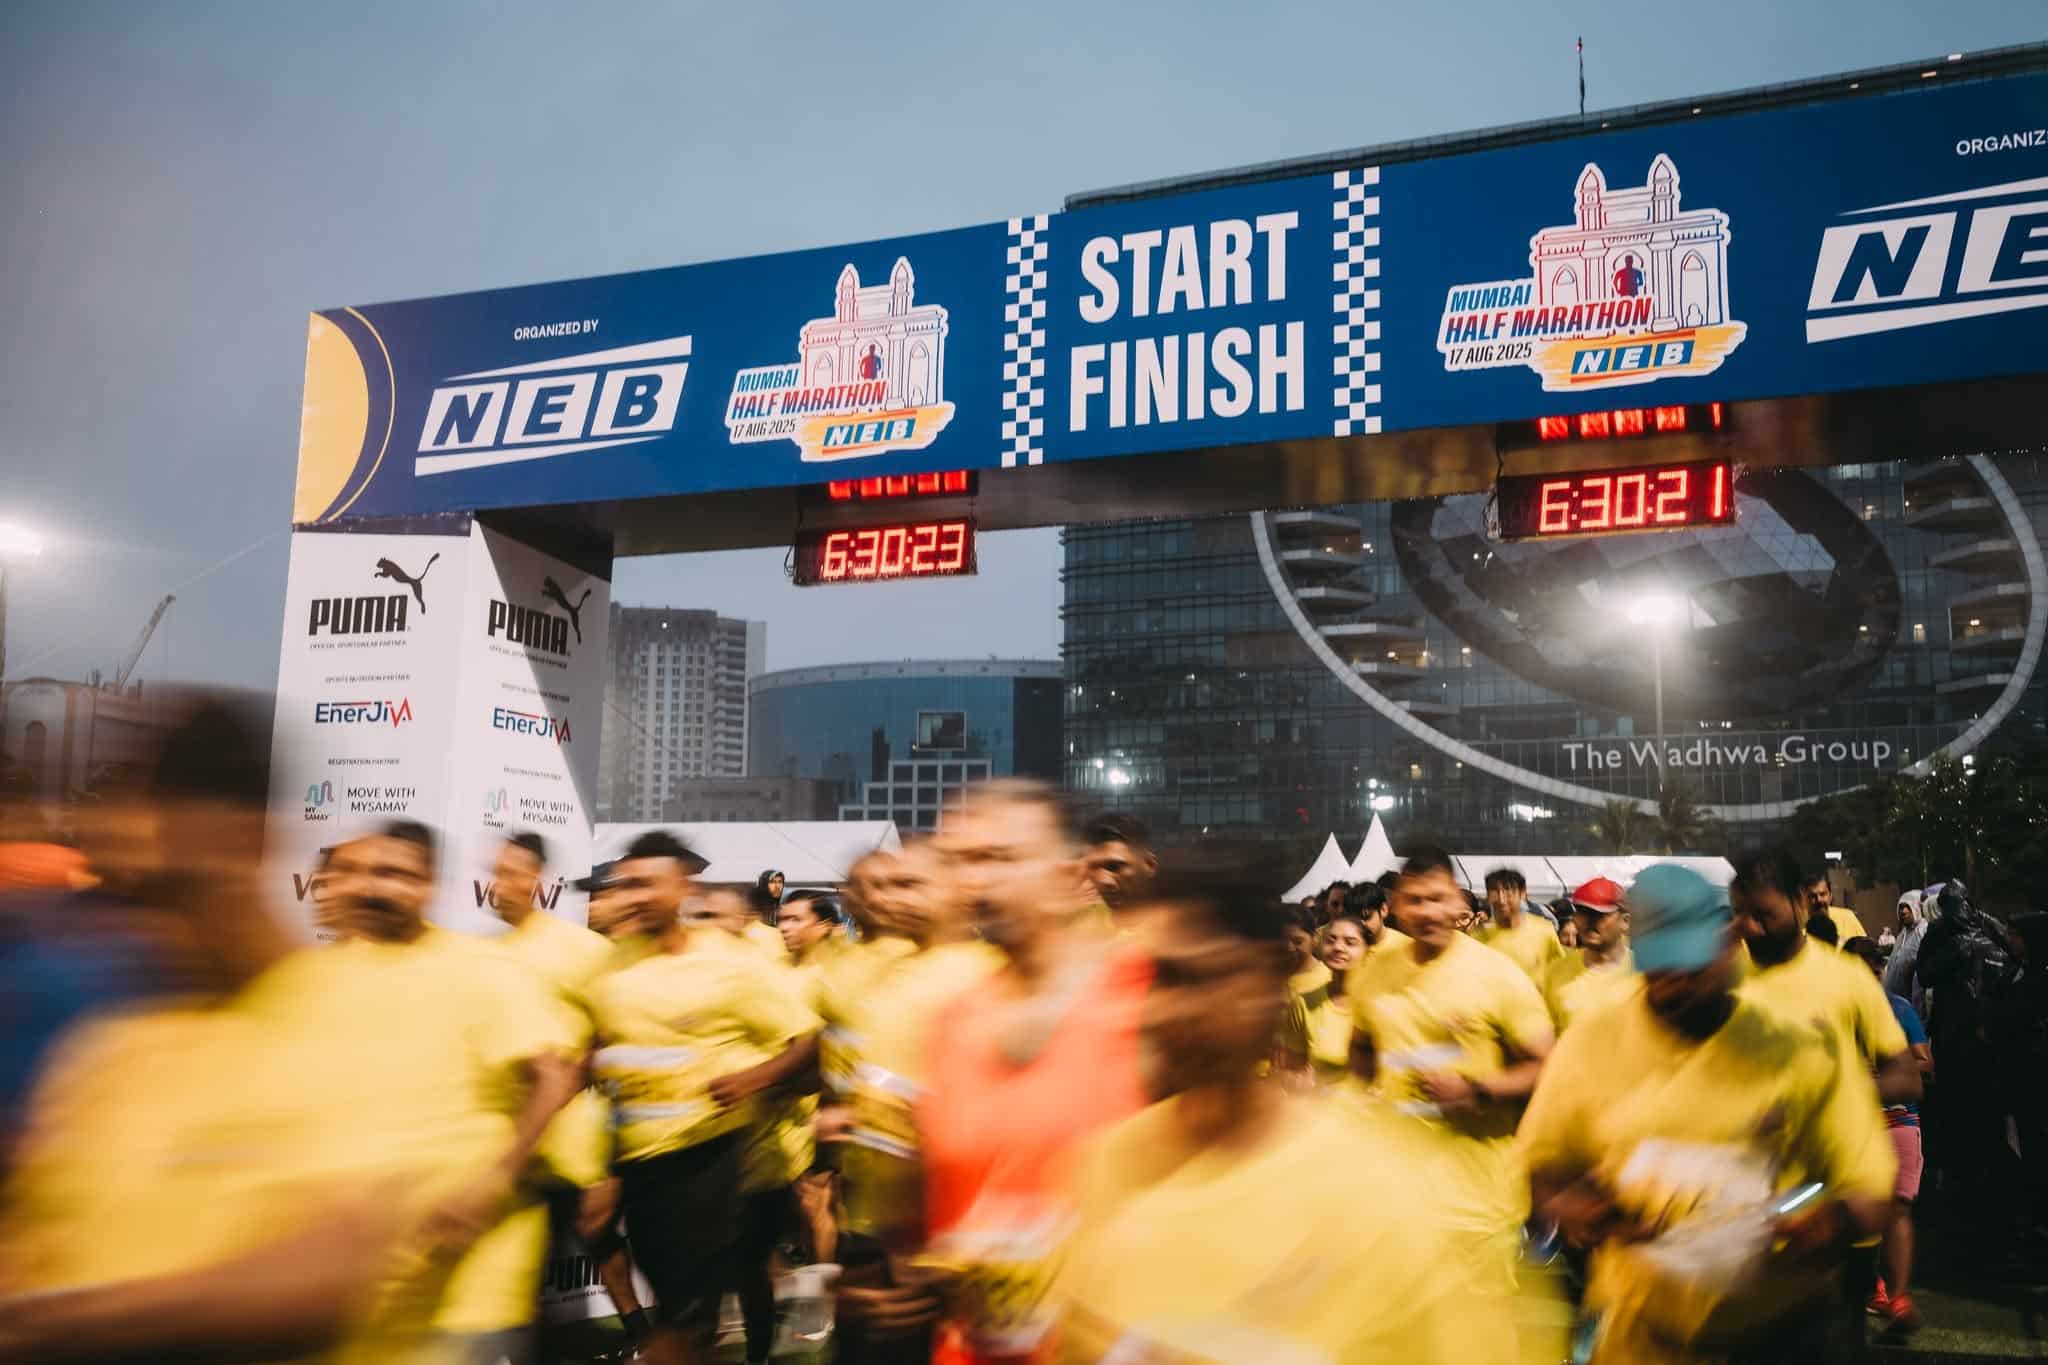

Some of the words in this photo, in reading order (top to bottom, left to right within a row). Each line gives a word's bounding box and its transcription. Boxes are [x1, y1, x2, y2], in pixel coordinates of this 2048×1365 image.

[1955, 129, 2048, 156] ORGANIZ
[1078, 210, 1299, 323] START
[1829, 210, 2048, 305] NE
[1450, 284, 1532, 313] MUMBAI
[513, 320, 581, 341] ORGANIZED
[582, 318, 600, 334] BY
[1445, 311, 1508, 345] HALF
[1511, 297, 1652, 337] MARATHON
[1449, 348, 1464, 366] 17
[1465, 345, 1494, 364] AUG
[1495, 342, 1533, 362] 2025
[1574, 341, 1691, 374] NEB
[737, 368, 799, 392] MUMBAI
[1069, 320, 1305, 433] FINISH
[429, 371, 668, 449] NEB
[731, 393, 780, 419] HALF
[780, 380, 888, 415] MARATHON
[734, 423, 745, 439] 17
[745, 421, 767, 437] AUG
[768, 418, 797, 435] 2025
[825, 419, 915, 446] NEB
[1539, 465, 1724, 532] 6:30:21
[823, 523, 966, 578] 6:30:23
[308, 595, 409, 636] PUMA
[487, 599, 569, 656] PUMA
[1562, 741, 1622, 770] The
[1630, 738, 1769, 768] Wadhwa
[1780, 734, 1891, 768] Group
[347, 787, 381, 799] MOVE
[385, 786, 416, 799] WITH
[350, 801, 408, 813] MYSAMAY
[519, 797, 547, 810] MOVE
[550, 800, 574, 814] WITH
[304, 813, 329, 822] SAMAY
[305, 806, 317, 814] MY
[522, 811, 568, 825] MYSAMAY
